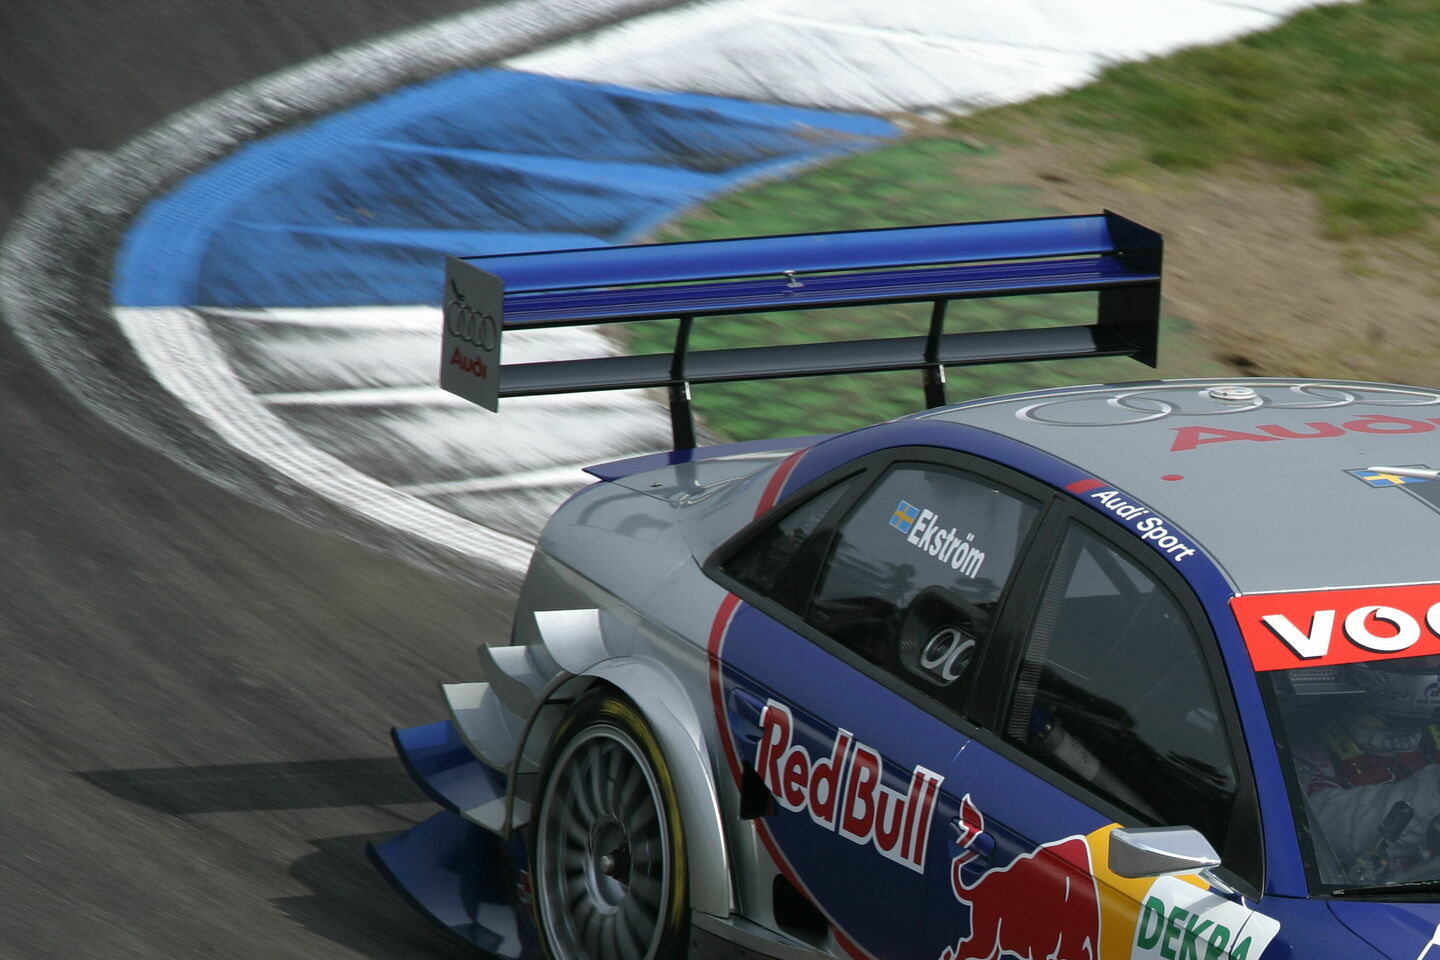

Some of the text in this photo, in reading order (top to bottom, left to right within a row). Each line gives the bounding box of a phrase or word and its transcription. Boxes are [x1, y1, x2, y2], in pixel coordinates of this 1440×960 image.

[450, 347, 488, 380] Audi
[906, 508, 985, 579] Ekström
[1091, 490, 1196, 562] Audi Sport
